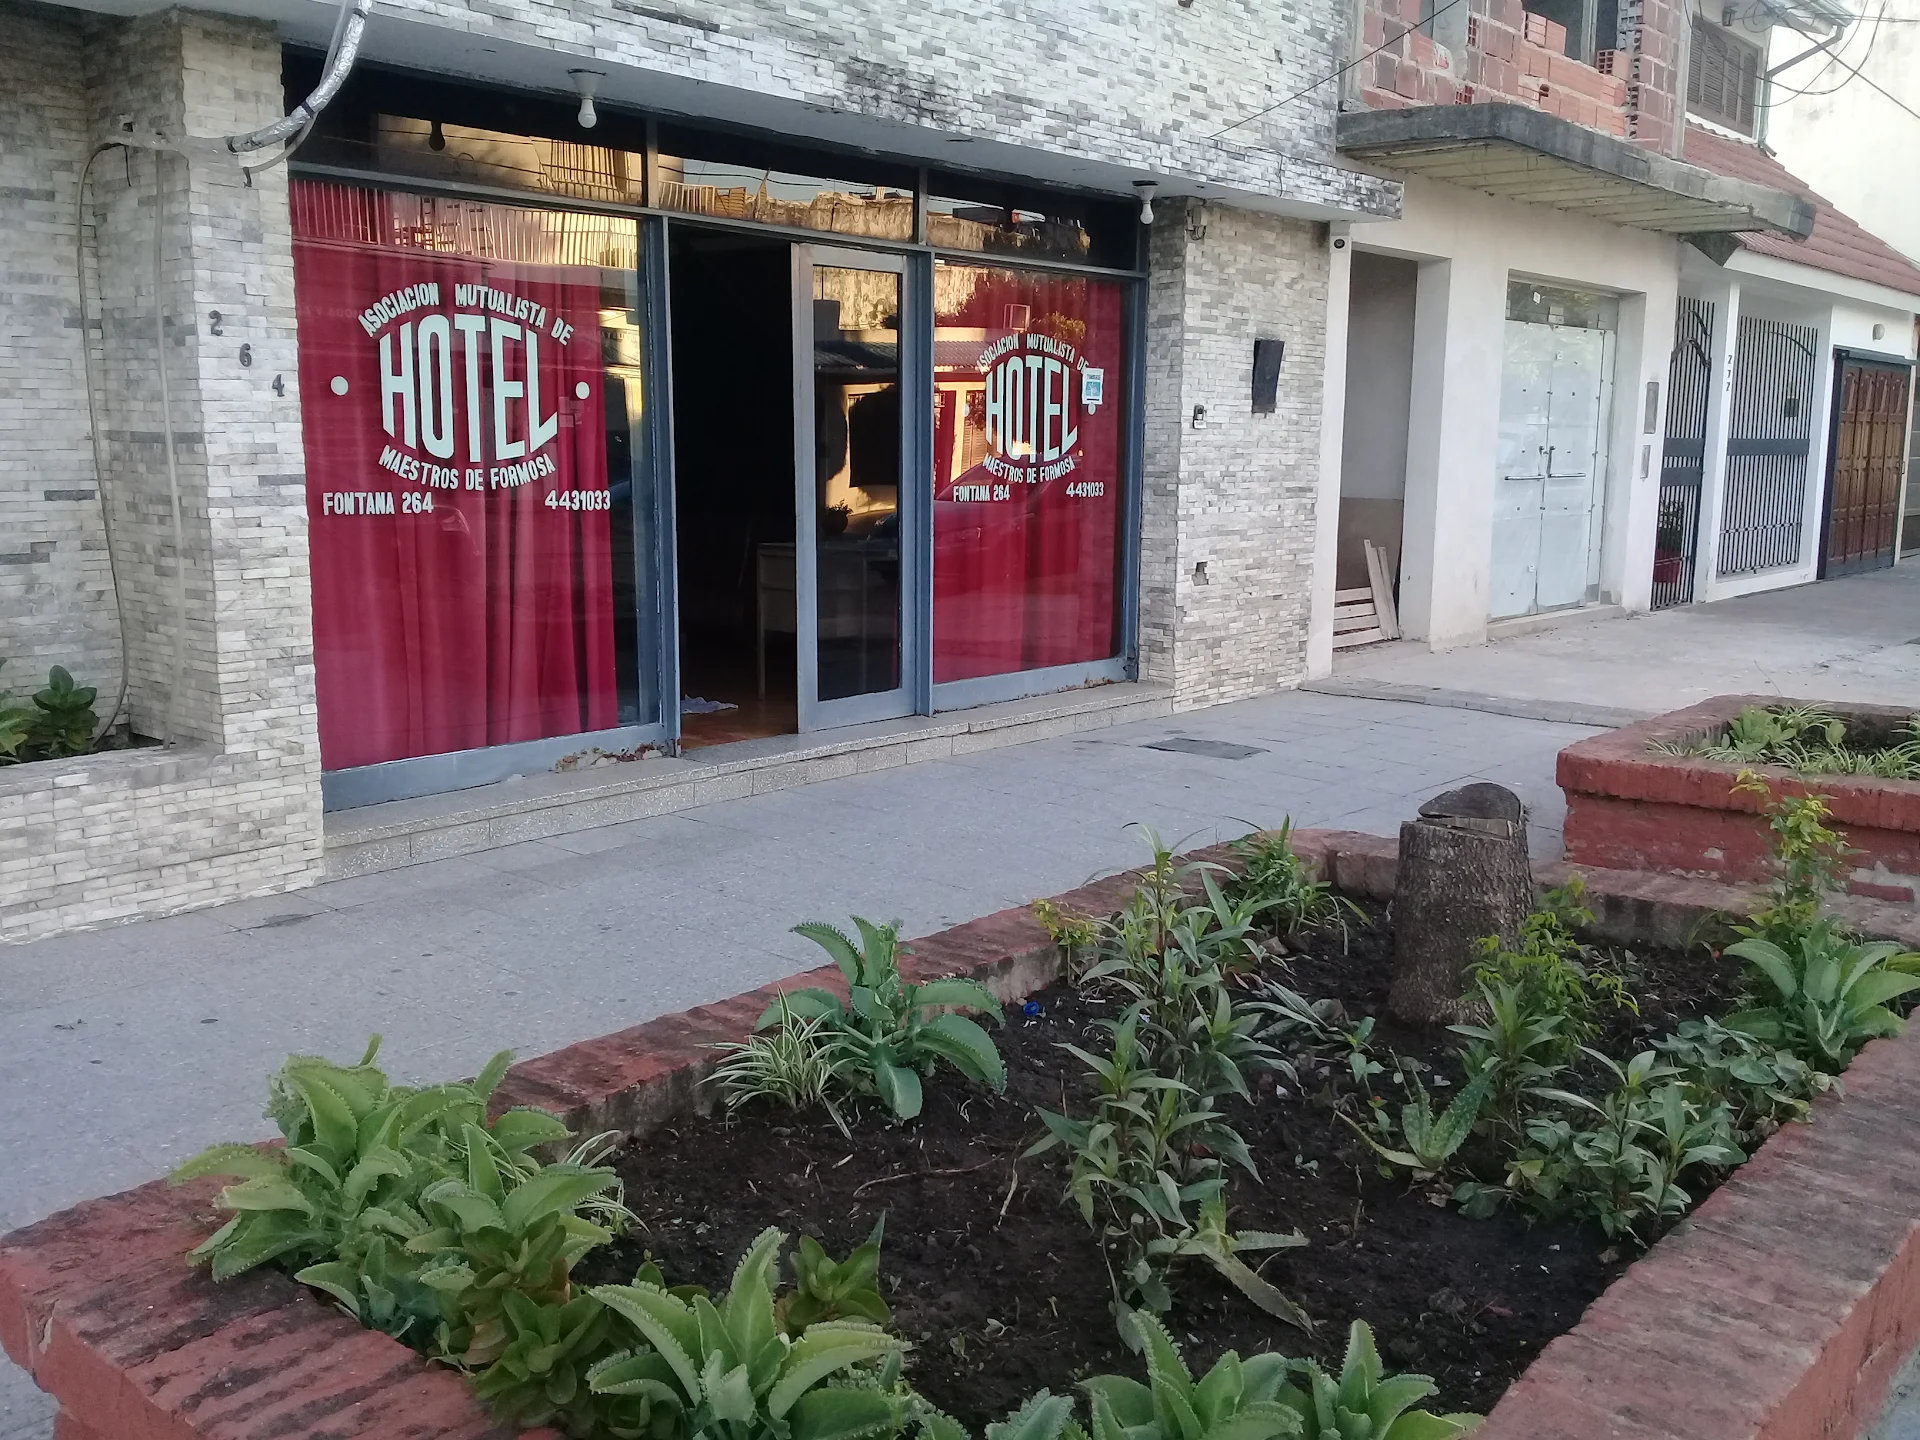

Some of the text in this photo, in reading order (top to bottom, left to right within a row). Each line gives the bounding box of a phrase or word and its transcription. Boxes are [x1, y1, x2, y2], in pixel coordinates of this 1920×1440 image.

[358, 282, 574, 346] ASOCIACION MUTUALISTA DE
[976, 333, 1019, 375] ASOCIACION
[1026, 333, 1075, 362] MUTUALISTA
[379, 313, 558, 463] HOTEL
[985, 355, 1078, 463] HOTEL
[379, 445, 556, 491] MAESTROS DE FORMOSA
[982, 452, 1076, 484] MAESTROS DE FORMOSA
[323, 491, 434, 516] FONTANA 264
[544, 489, 611, 511] 4431033
[953, 484, 1010, 502] FONTANA 264
[1066, 481, 1104, 498] 4431033
